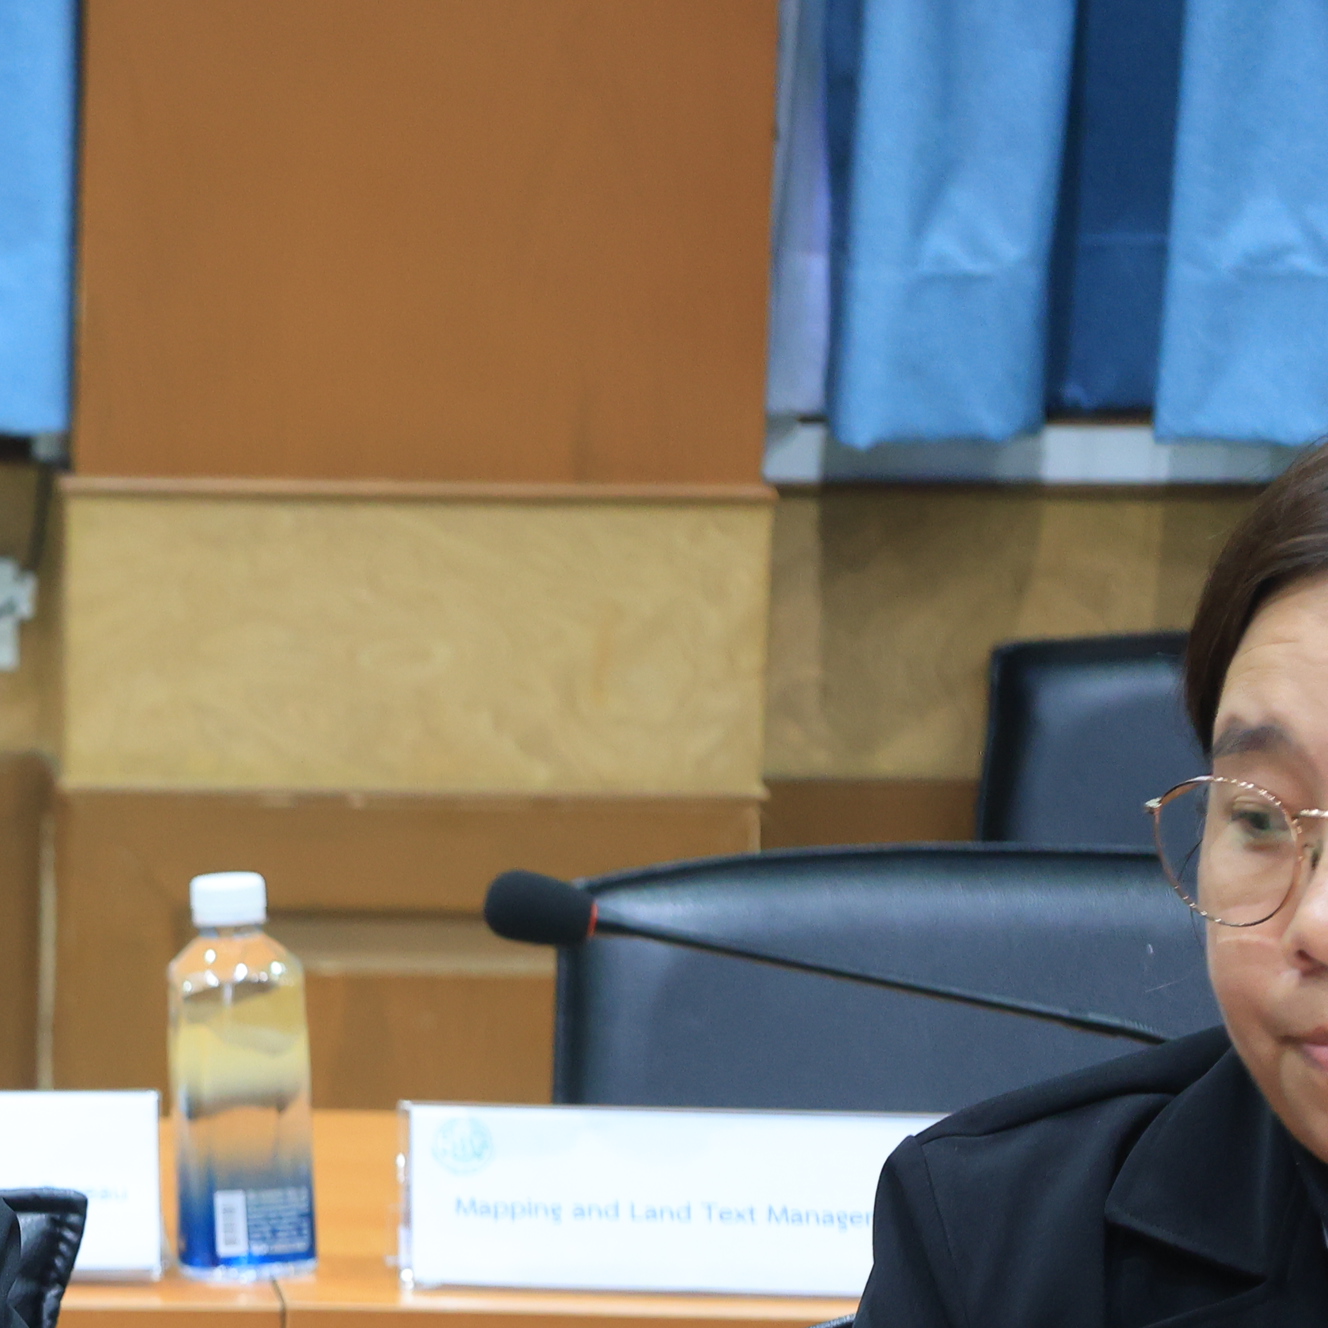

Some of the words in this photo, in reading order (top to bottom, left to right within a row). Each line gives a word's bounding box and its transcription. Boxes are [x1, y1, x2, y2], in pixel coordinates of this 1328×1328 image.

[454, 1196, 563, 1225] Mapping
[571, 1199, 621, 1221] and
[629, 1201, 693, 1223] Land
